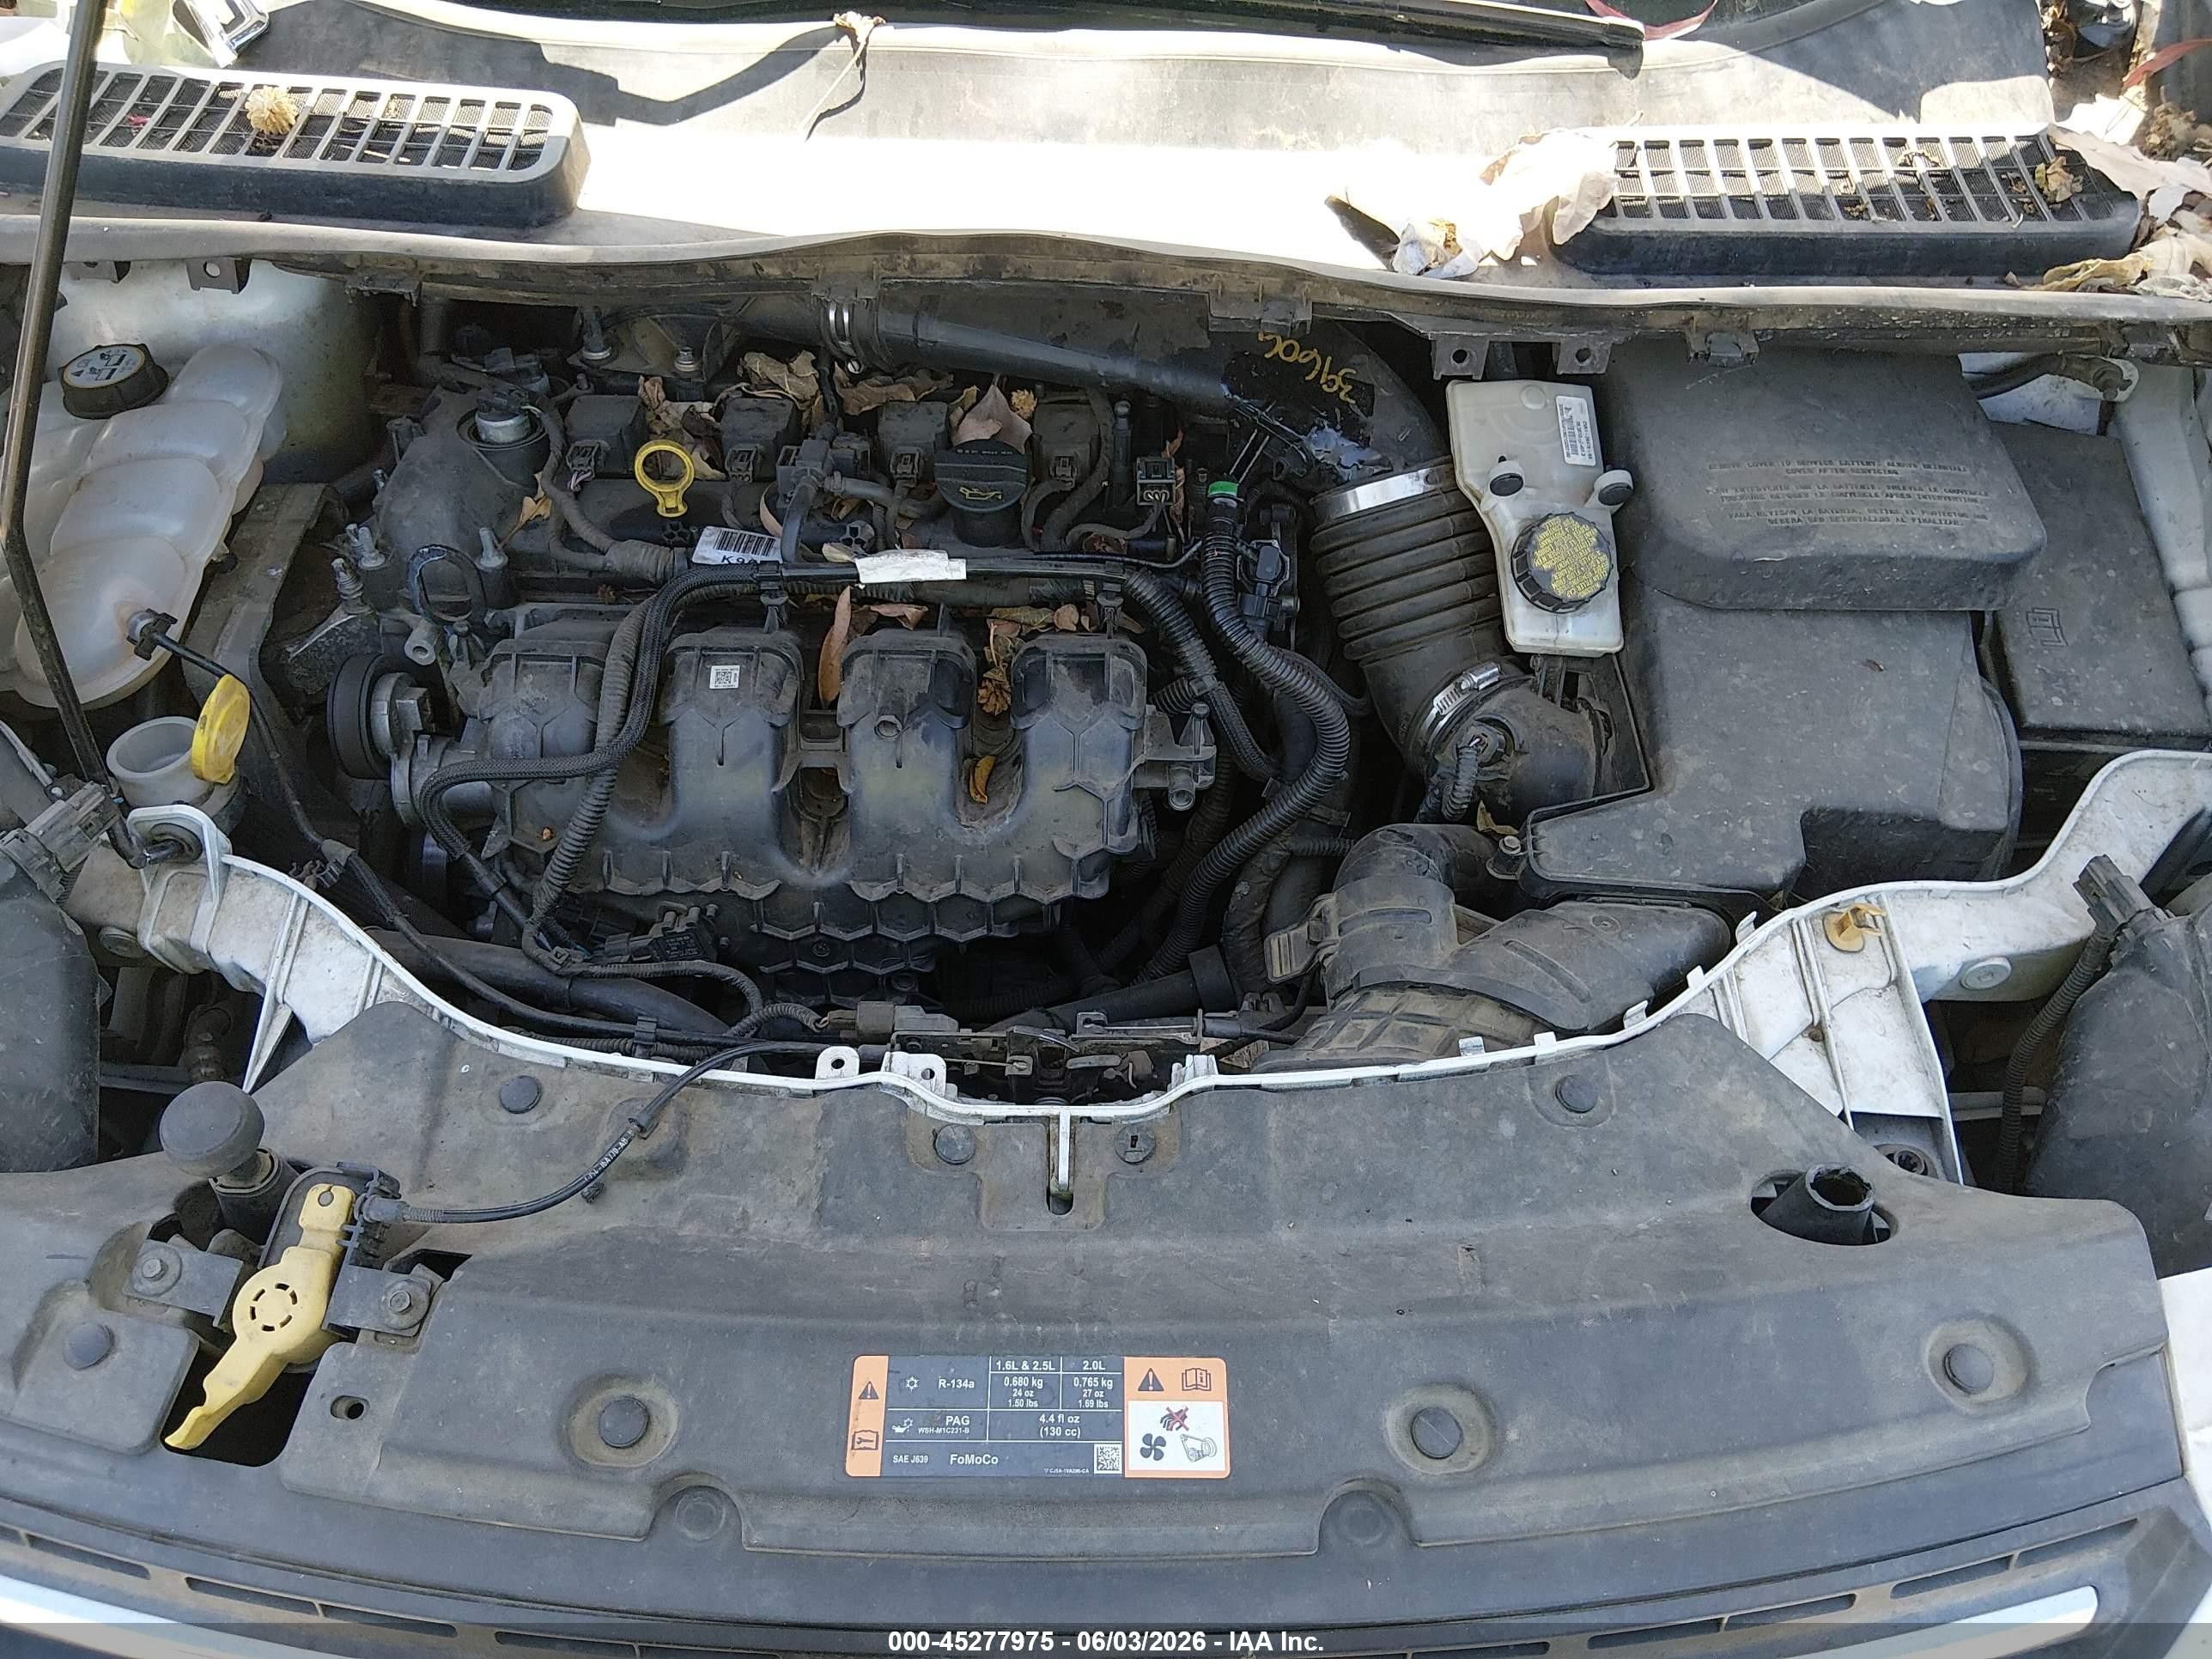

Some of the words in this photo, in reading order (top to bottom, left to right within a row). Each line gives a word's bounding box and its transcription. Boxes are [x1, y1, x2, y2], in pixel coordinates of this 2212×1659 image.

[995, 1359, 1019, 1371] 1.6L
[1021, 1360, 1030, 1370] &
[1032, 1360, 1056, 1371] 2.5L
[1082, 1359, 1106, 1370] 2.0L
[938, 1378, 975, 1389] R-134a
[1003, 1376, 1030, 1388] 0.680
[1031, 1376, 1043, 1389] kg
[1073, 1376, 1099, 1389] 0.765
[1101, 1376, 1114, 1389] kg
[1012, 1388, 1023, 1398] 24
[1024, 1389, 1035, 1398] oz
[1082, 1389, 1093, 1398] 27
[1007, 1398, 1024, 1408] 1.50
[1025, 1398, 1039, 1408] lbs
[1078, 1399, 1095, 1409] 1.69
[1096, 1399, 1109, 1408] lbs
[945, 1415, 970, 1426] PAG
[1039, 1413, 1055, 1424] 4.4
[1057, 1413, 1065, 1424] fl
[1066, 1415, 1081, 1424] oz
[1039, 1425, 1062, 1438] (130
[1064, 1425, 1081, 1439] cc)
[892, 1455, 909, 1463] SAE
[910, 1455, 929, 1464] J639
[950, 1454, 999, 1465] FoMoCo
